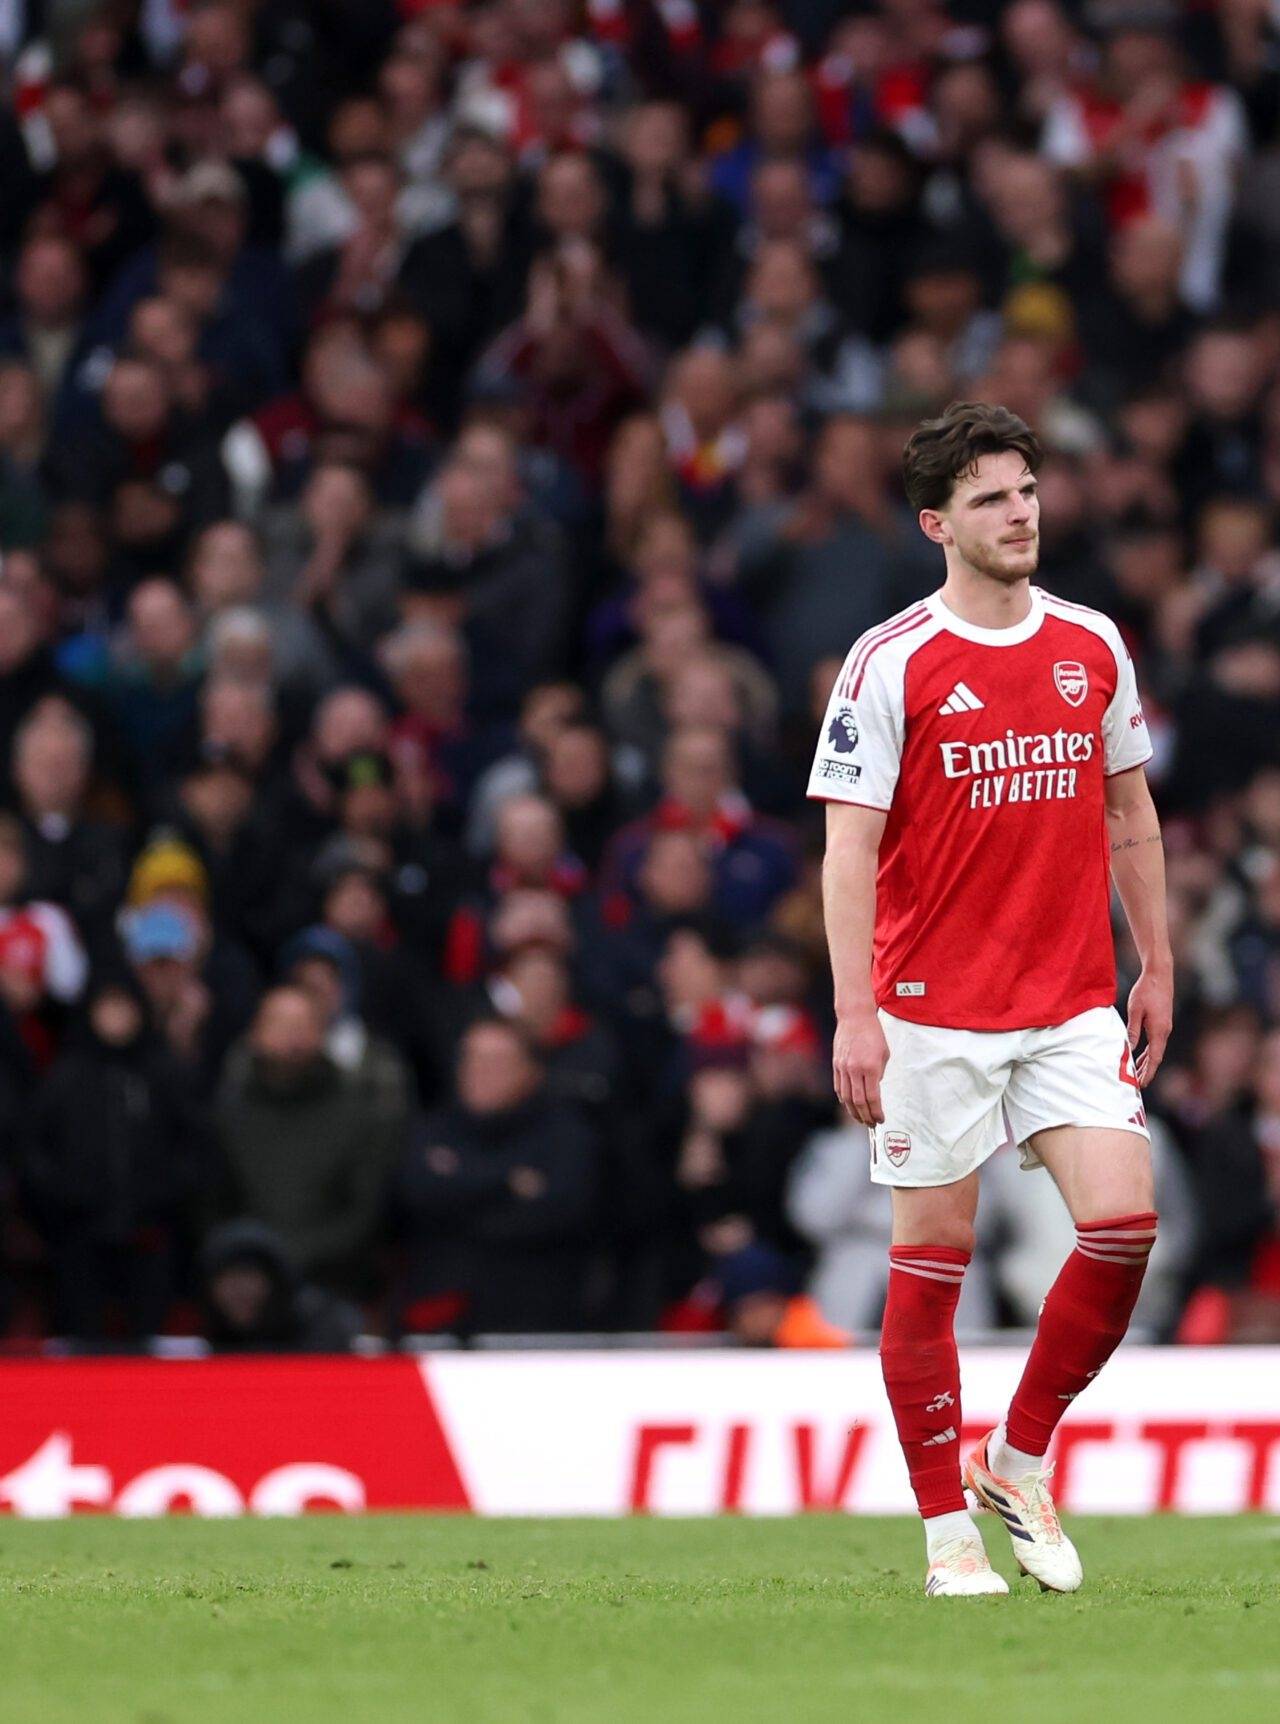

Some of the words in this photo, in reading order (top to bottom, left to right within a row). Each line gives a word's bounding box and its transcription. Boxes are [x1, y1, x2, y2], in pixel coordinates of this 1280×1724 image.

[829, 762, 857, 775] room
[938, 727, 1095, 779] Emirates
[970, 775, 1005, 809] FLY
[1007, 768, 1077, 803] BETTER
